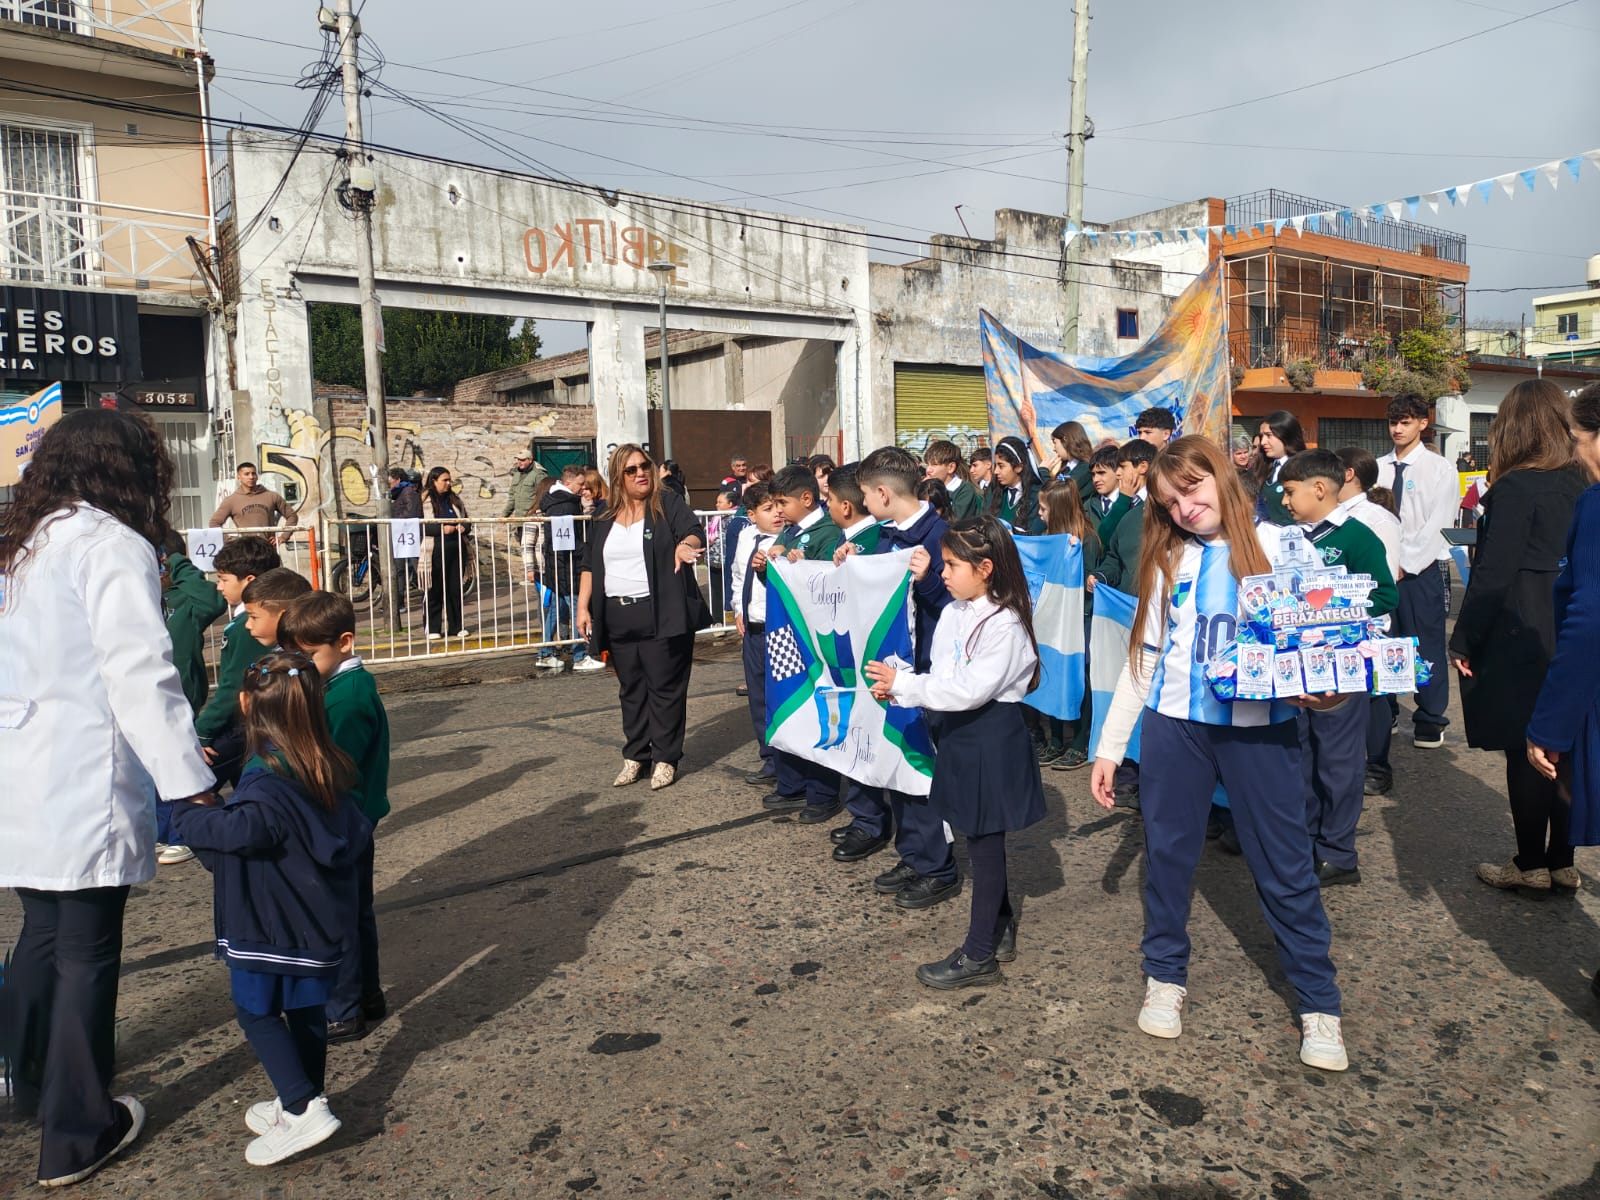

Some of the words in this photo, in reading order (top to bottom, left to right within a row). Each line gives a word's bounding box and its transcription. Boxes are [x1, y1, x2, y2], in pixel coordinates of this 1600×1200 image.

[145, 392, 187, 405] 3053
[15, 444, 29, 458] SAN
[397, 532, 416, 546] 43
[556, 527, 571, 540] 44
[195, 543, 217, 558] 42
[807, 571, 847, 622] Colegio
[1273, 606, 1367, 626] BERAZATEGUI
[1195, 613, 1237, 664] 10
